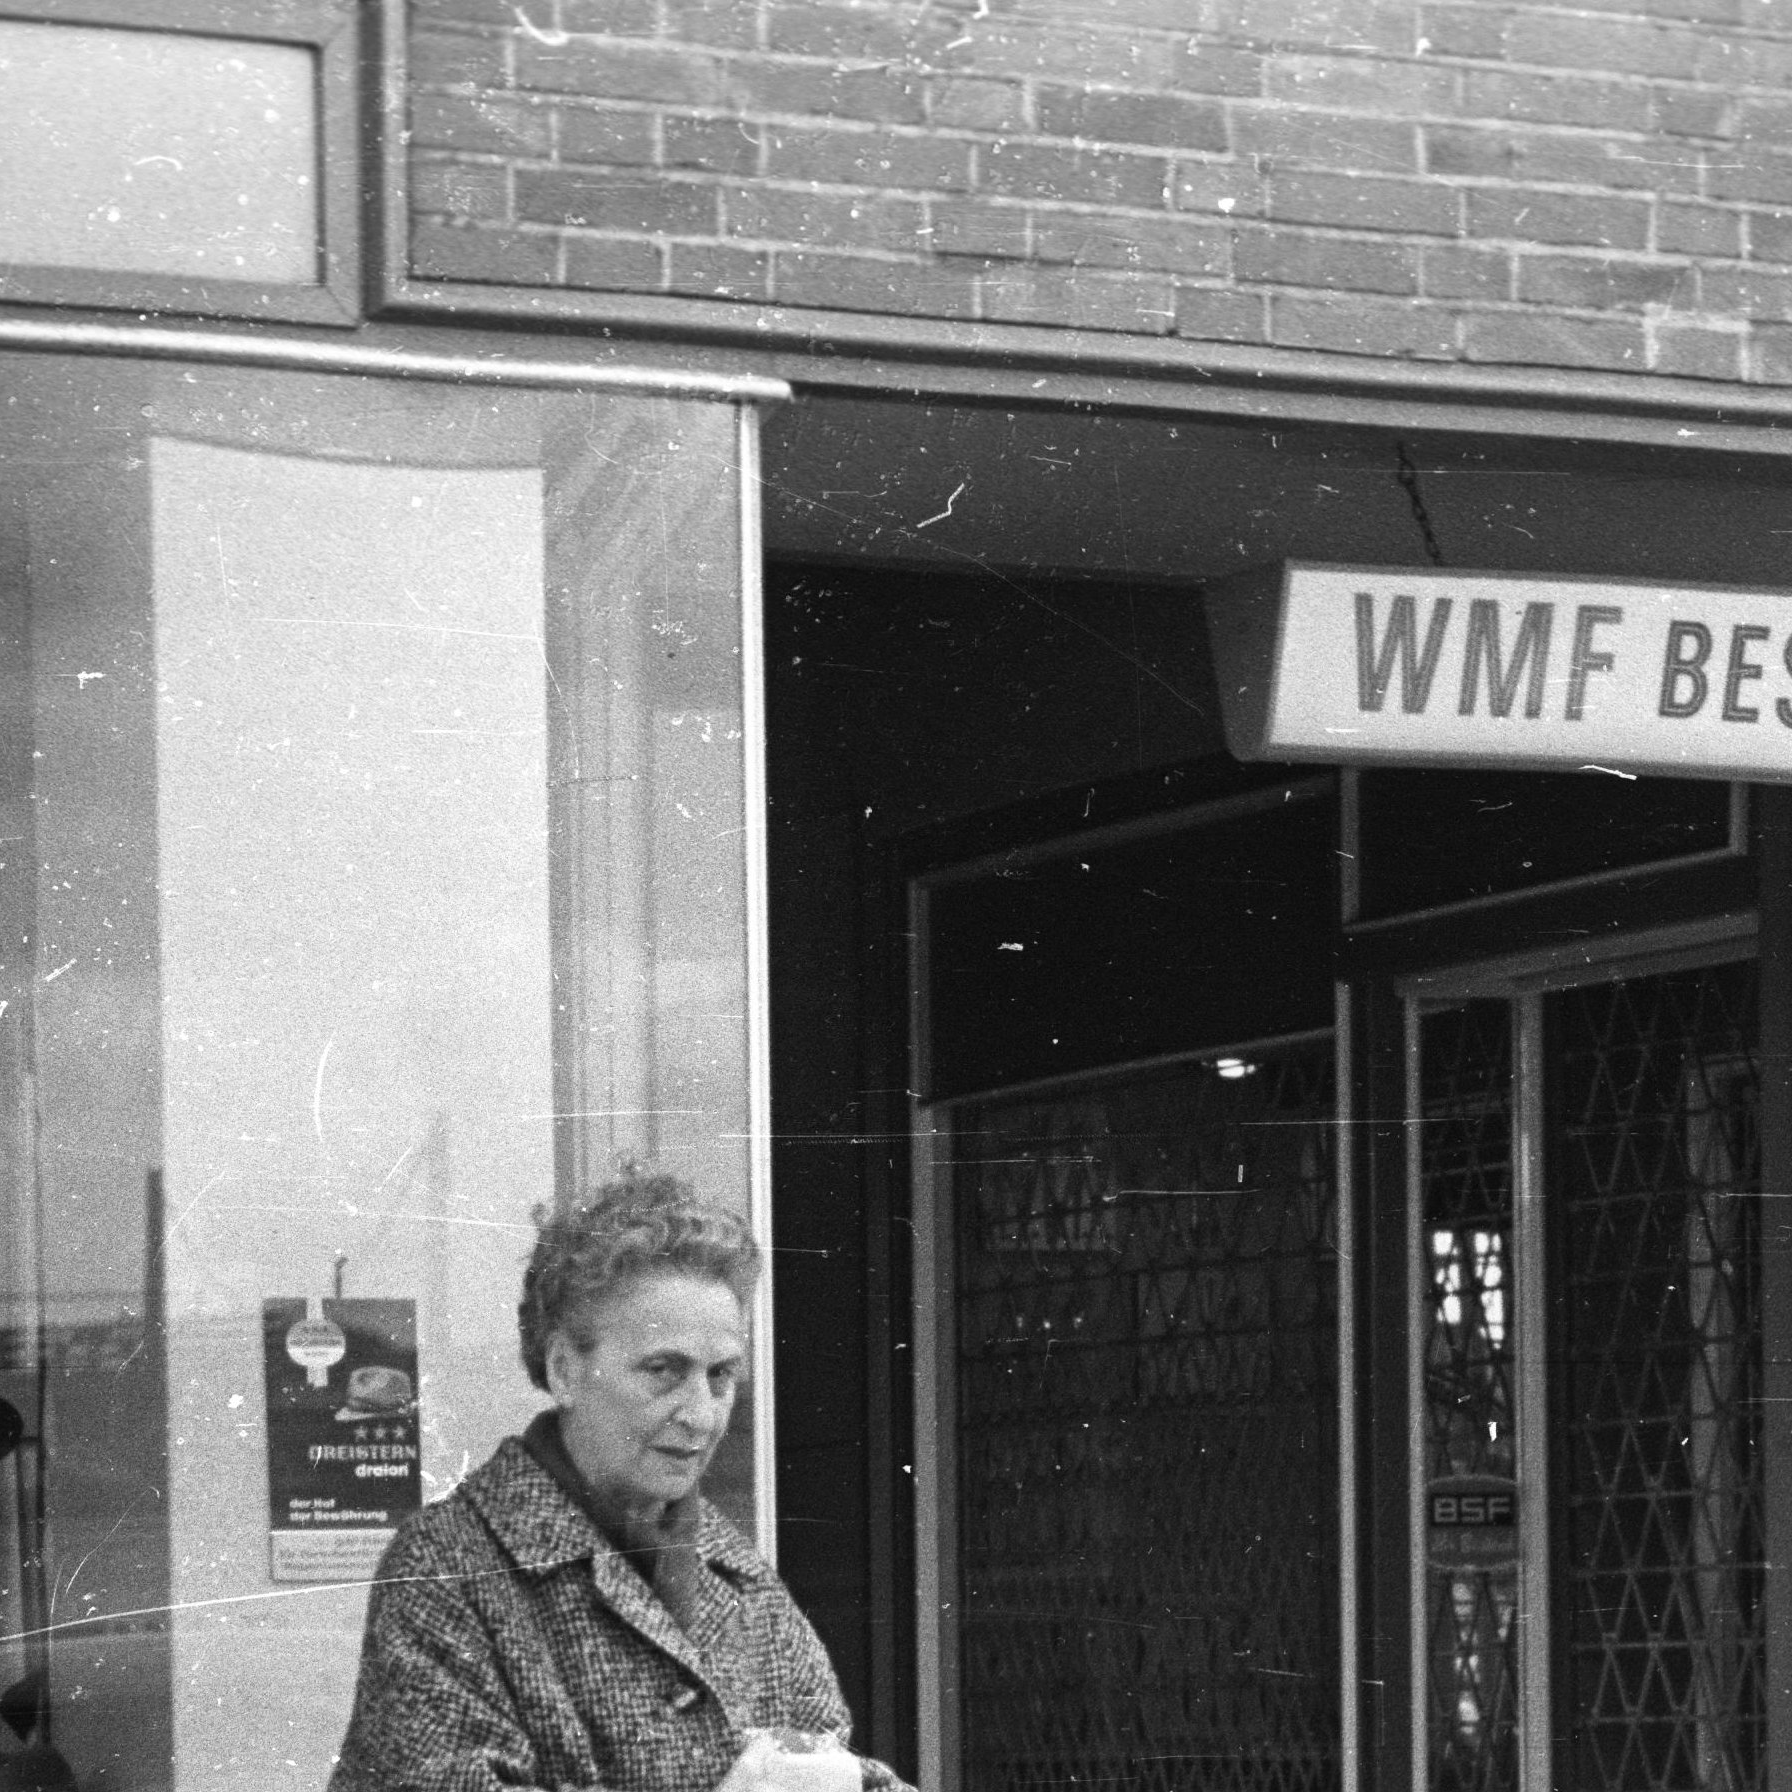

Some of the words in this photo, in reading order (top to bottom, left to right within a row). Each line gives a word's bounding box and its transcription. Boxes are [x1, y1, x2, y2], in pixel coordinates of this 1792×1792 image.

[1354, 592, 1622, 721] WMF
[308, 1444, 416, 1461] DREISTERN
[1434, 1497, 1509, 1523] BSF
